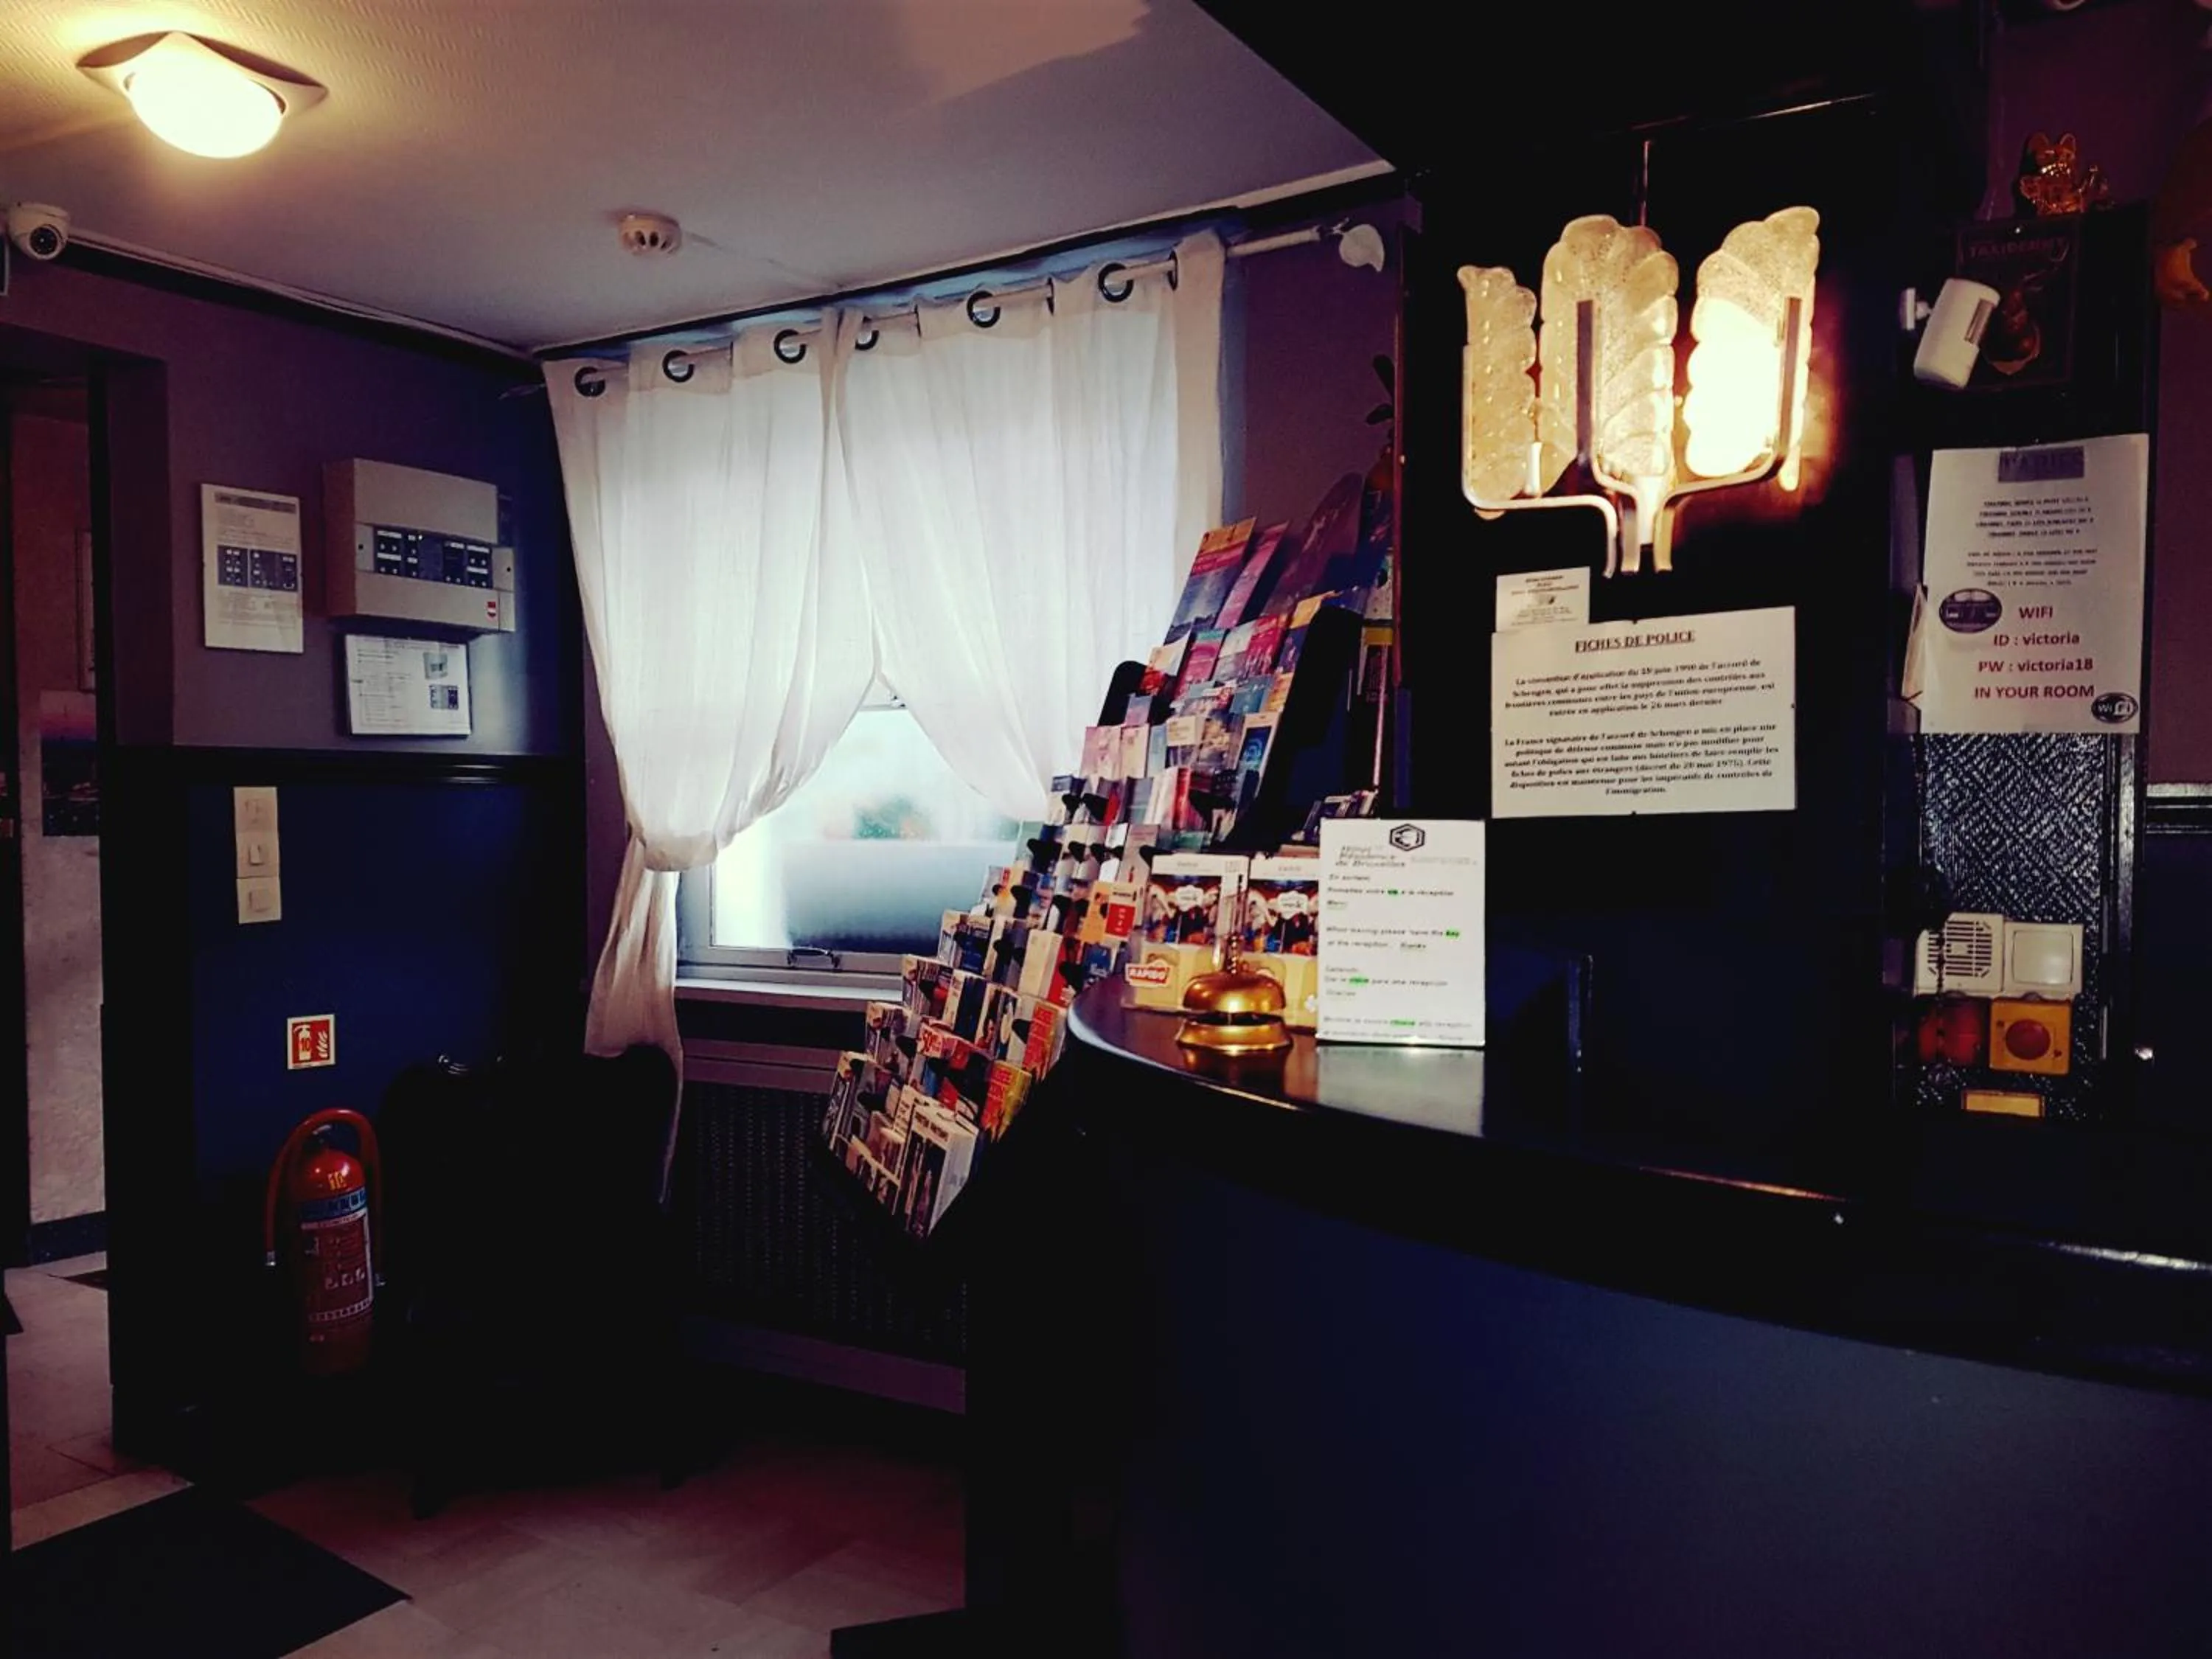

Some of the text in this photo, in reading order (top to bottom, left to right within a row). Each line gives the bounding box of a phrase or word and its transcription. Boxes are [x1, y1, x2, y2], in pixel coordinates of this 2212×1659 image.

[2019, 606, 2053, 619] WIFI
[1575, 630, 1695, 653] FICHES DE POLICE
[1993, 634, 2009, 646] ID
[2023, 632, 2080, 646] victoria
[1978, 660, 2004, 672] PW
[2018, 658, 2093, 672] victoria18
[1975, 684, 2095, 699] IN YOUR ROOM
